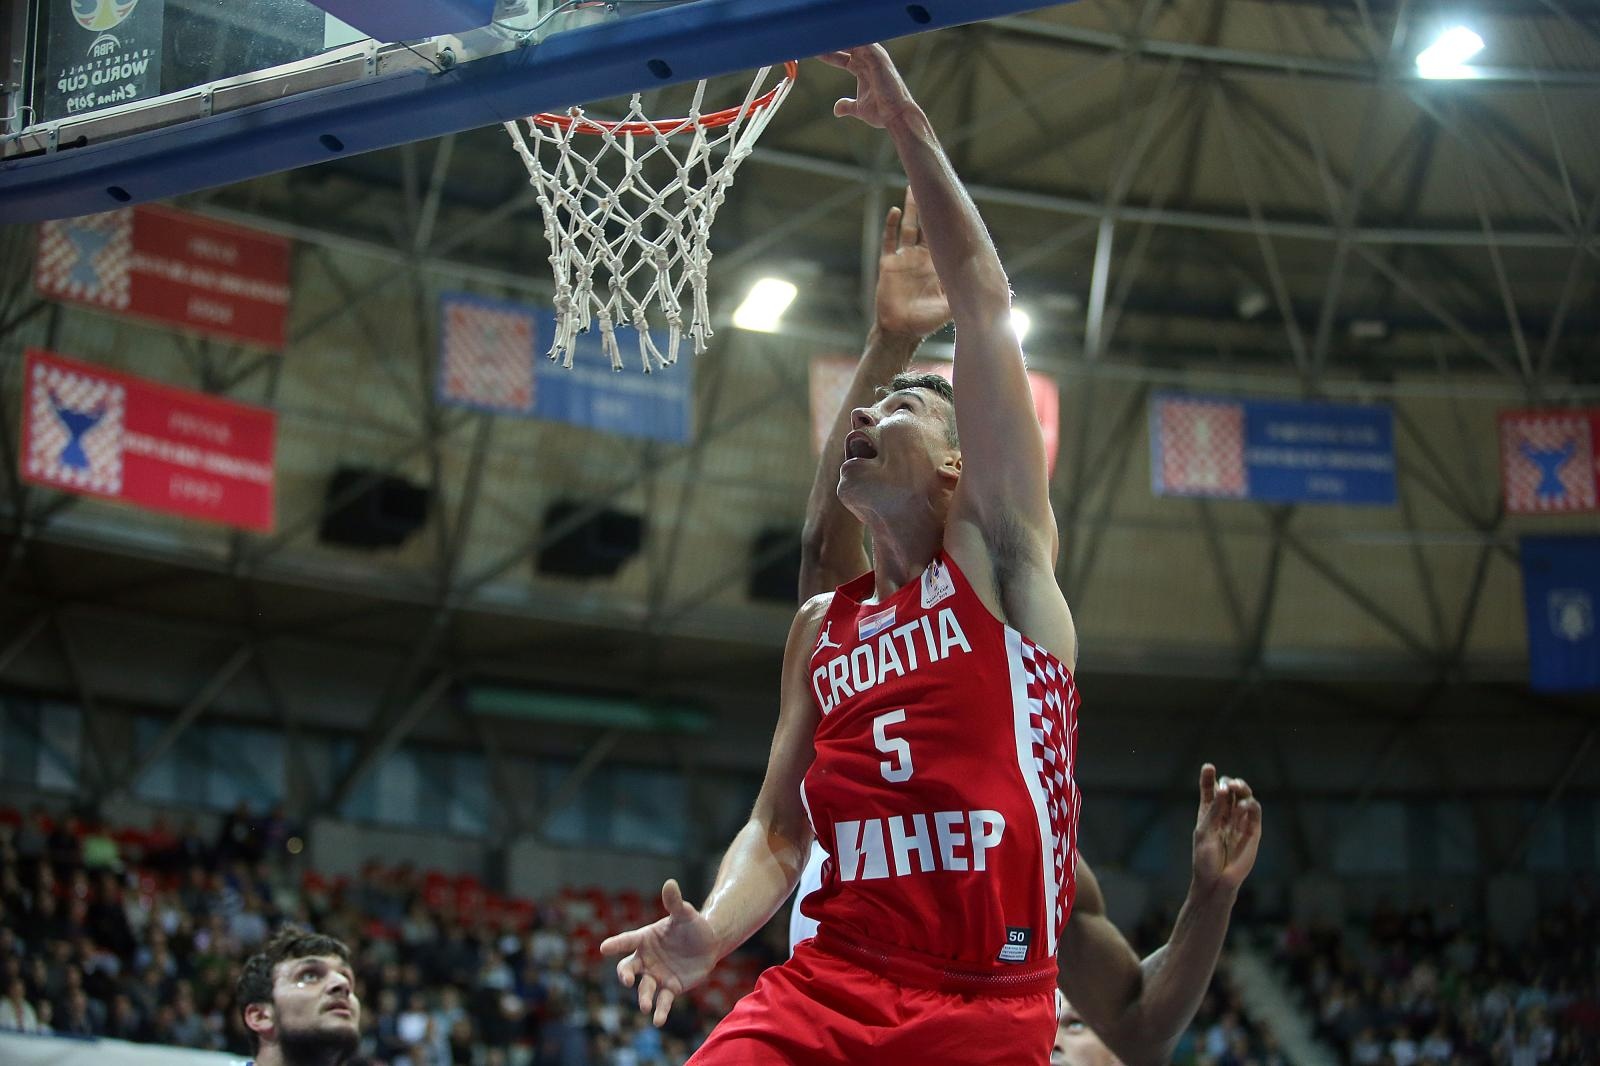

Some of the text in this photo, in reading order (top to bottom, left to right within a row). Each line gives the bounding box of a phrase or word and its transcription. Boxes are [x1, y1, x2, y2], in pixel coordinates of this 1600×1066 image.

[812, 607, 973, 716] CROATIA
[872, 708, 914, 783] 5
[888, 809, 1006, 877] HEP
[1009, 931, 1025, 942] 50
